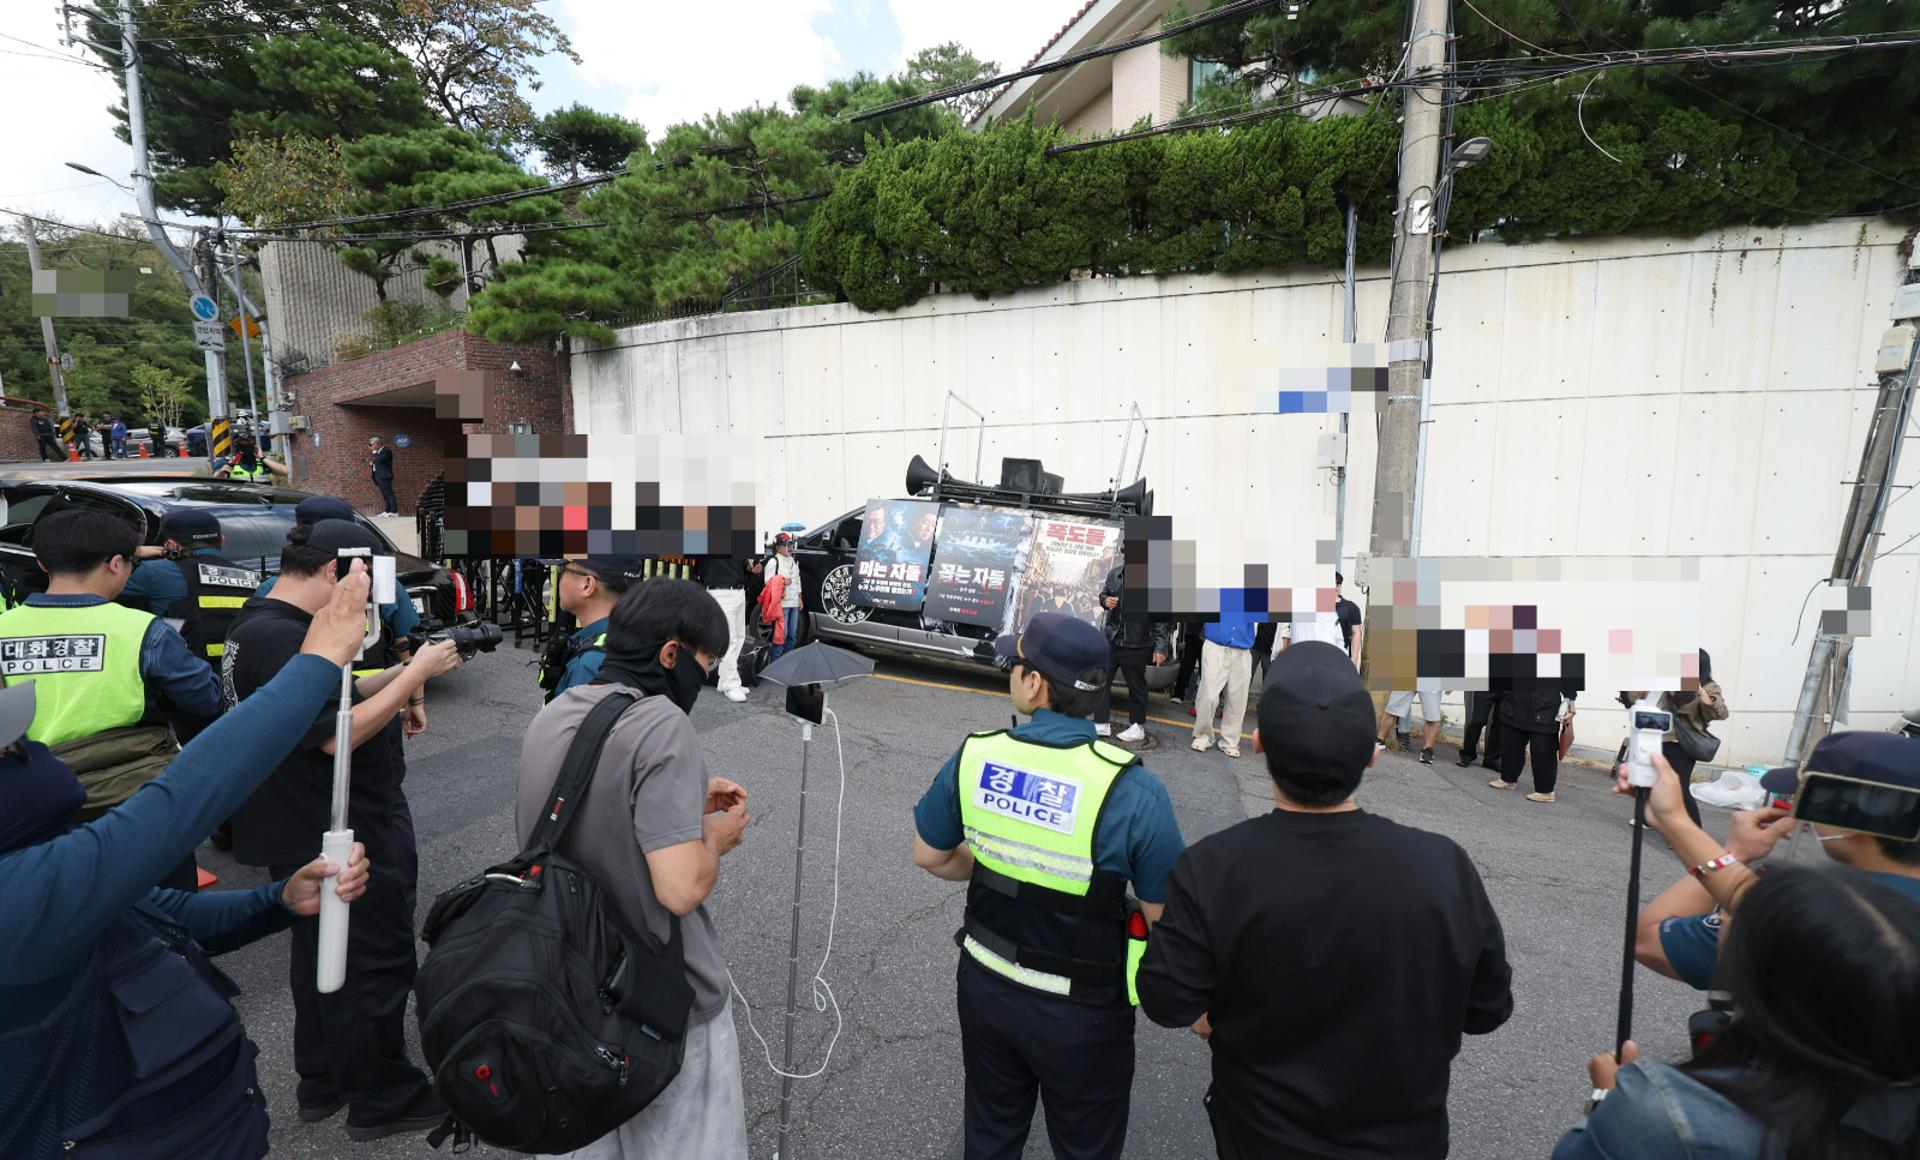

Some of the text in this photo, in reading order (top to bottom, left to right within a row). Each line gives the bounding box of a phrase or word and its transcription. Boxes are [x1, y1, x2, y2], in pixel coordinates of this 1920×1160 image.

[1046, 523, 1106, 546] 폭도들
[889, 563, 921, 582] 자들
[972, 568, 1005, 588] 자들
[4, 639, 96, 658] 대화경찰
[7, 658, 91, 672] POLICE
[989, 766, 1067, 809] 경찰
[983, 793, 1062, 826] POLICE
